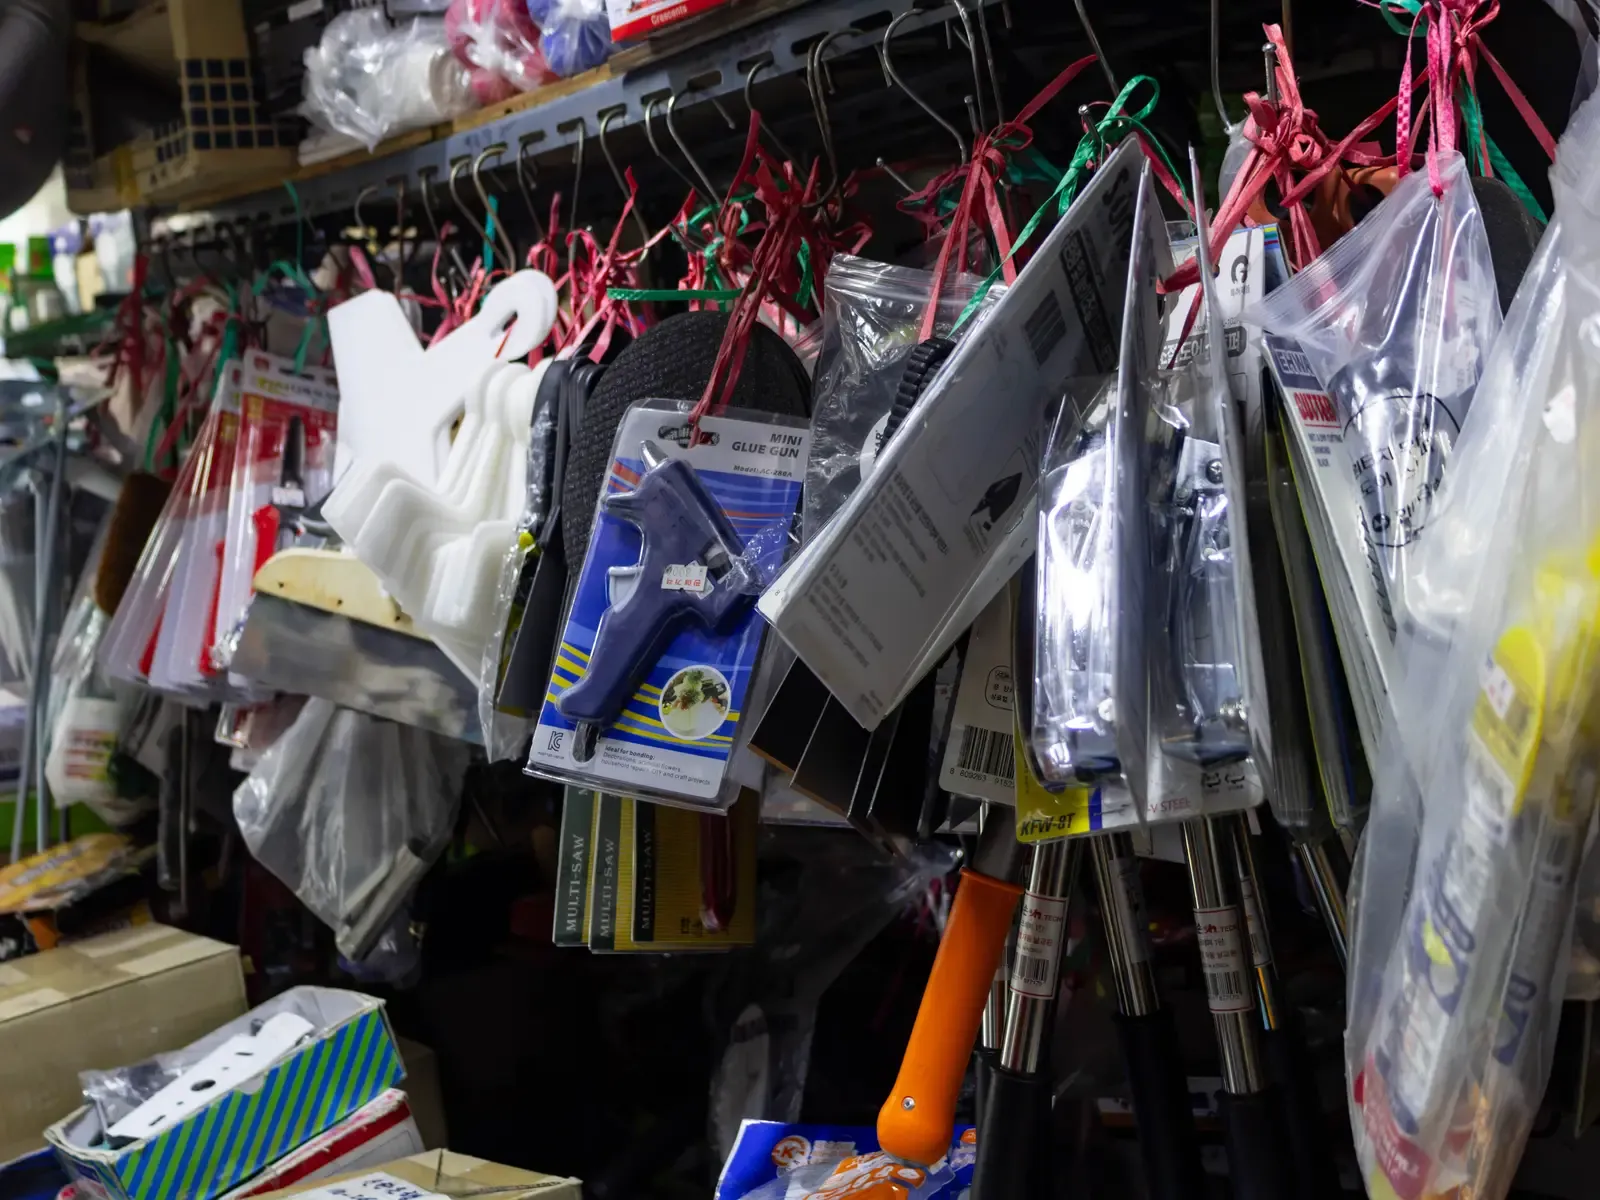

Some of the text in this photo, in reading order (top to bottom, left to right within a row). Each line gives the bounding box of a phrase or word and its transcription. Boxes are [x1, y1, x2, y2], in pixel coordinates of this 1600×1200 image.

[732, 441, 800, 459] GLUE GUN
[770, 433, 803, 446] MINI
[566, 834, 584, 932] MULTI-SAW
[600, 838, 615, 938] MULTI-SAW
